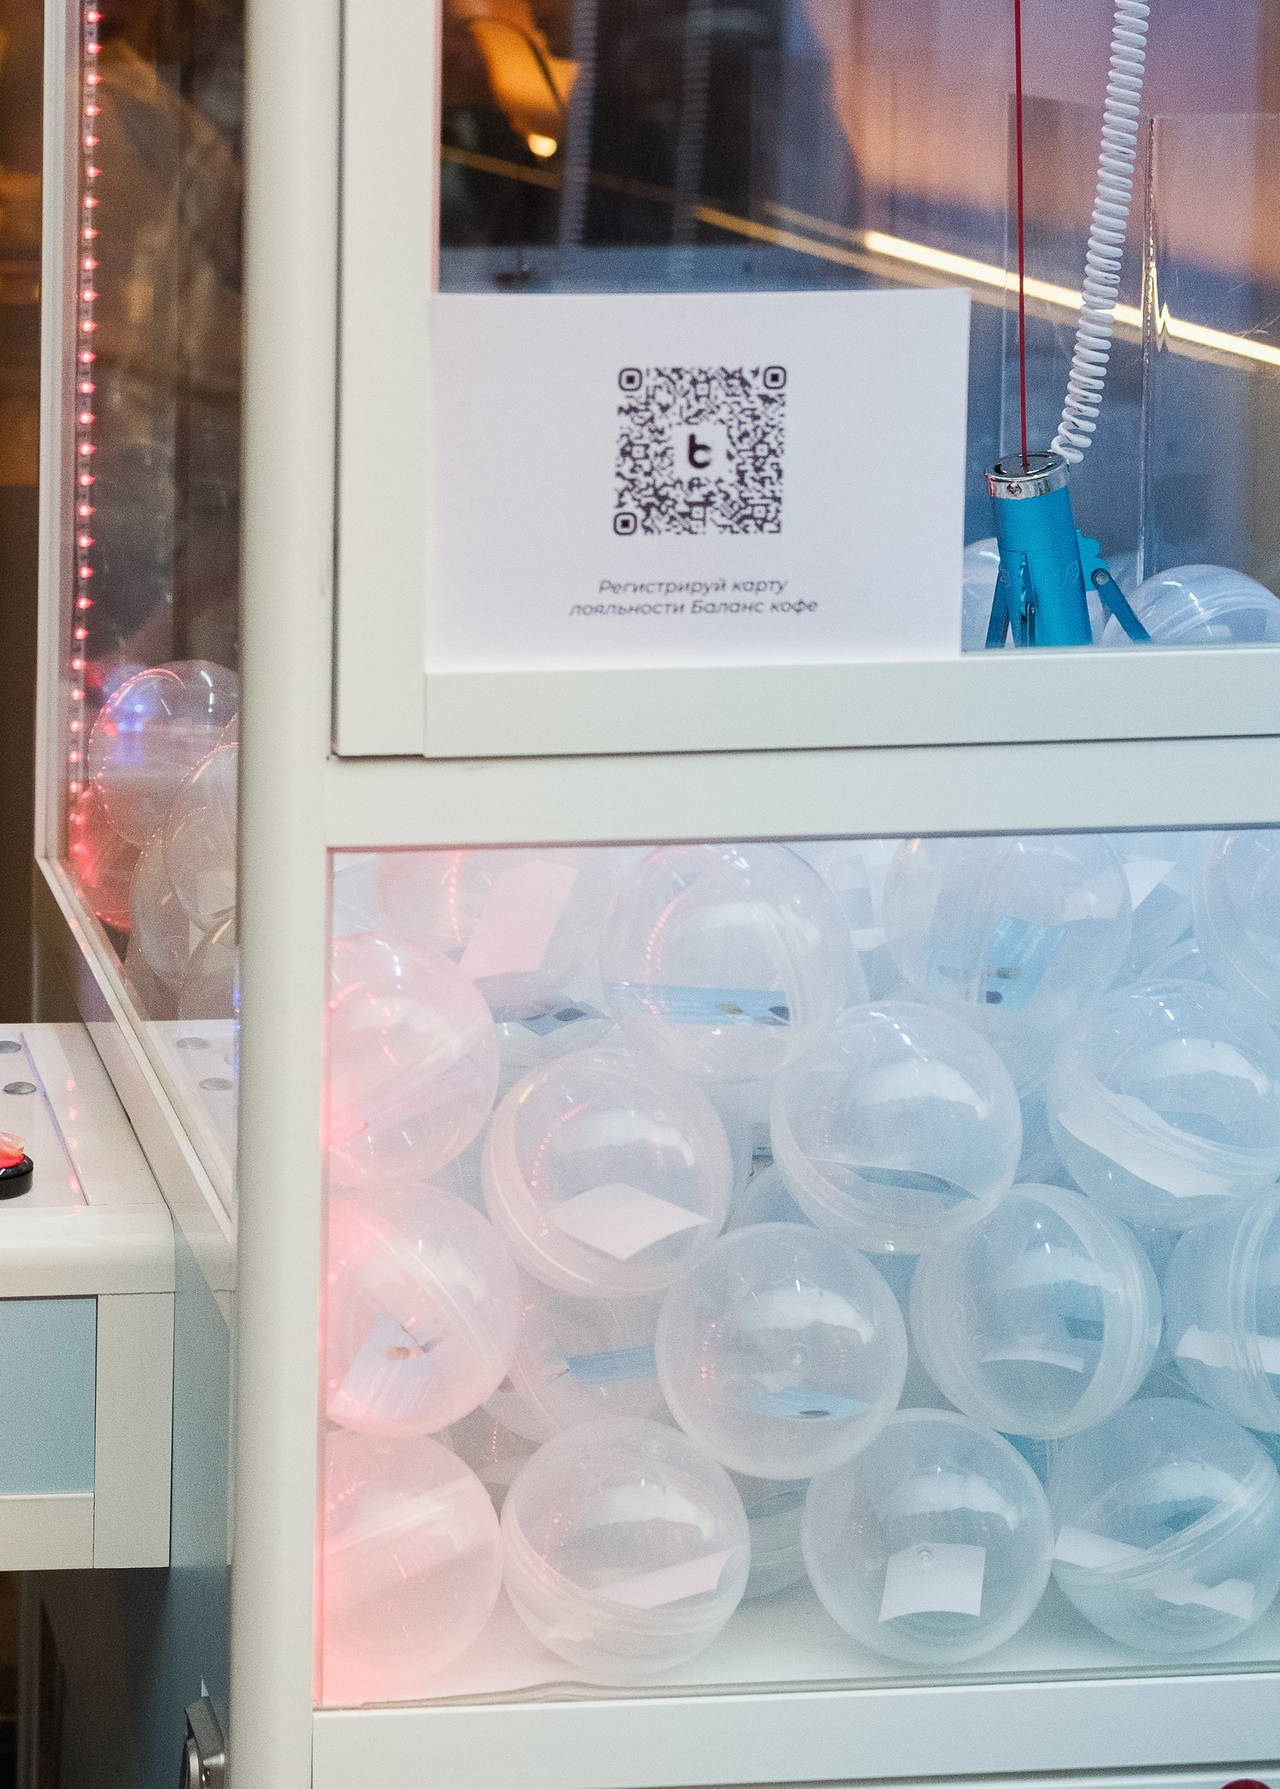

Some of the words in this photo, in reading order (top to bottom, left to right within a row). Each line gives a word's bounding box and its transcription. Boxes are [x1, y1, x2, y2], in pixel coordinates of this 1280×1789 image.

[598, 578, 726, 596] Регистрируй
[732, 580, 789, 596] карту
[569, 603, 685, 616] лояльности
[691, 599, 764, 614] Баланс
[770, 598, 818, 615] кофе
